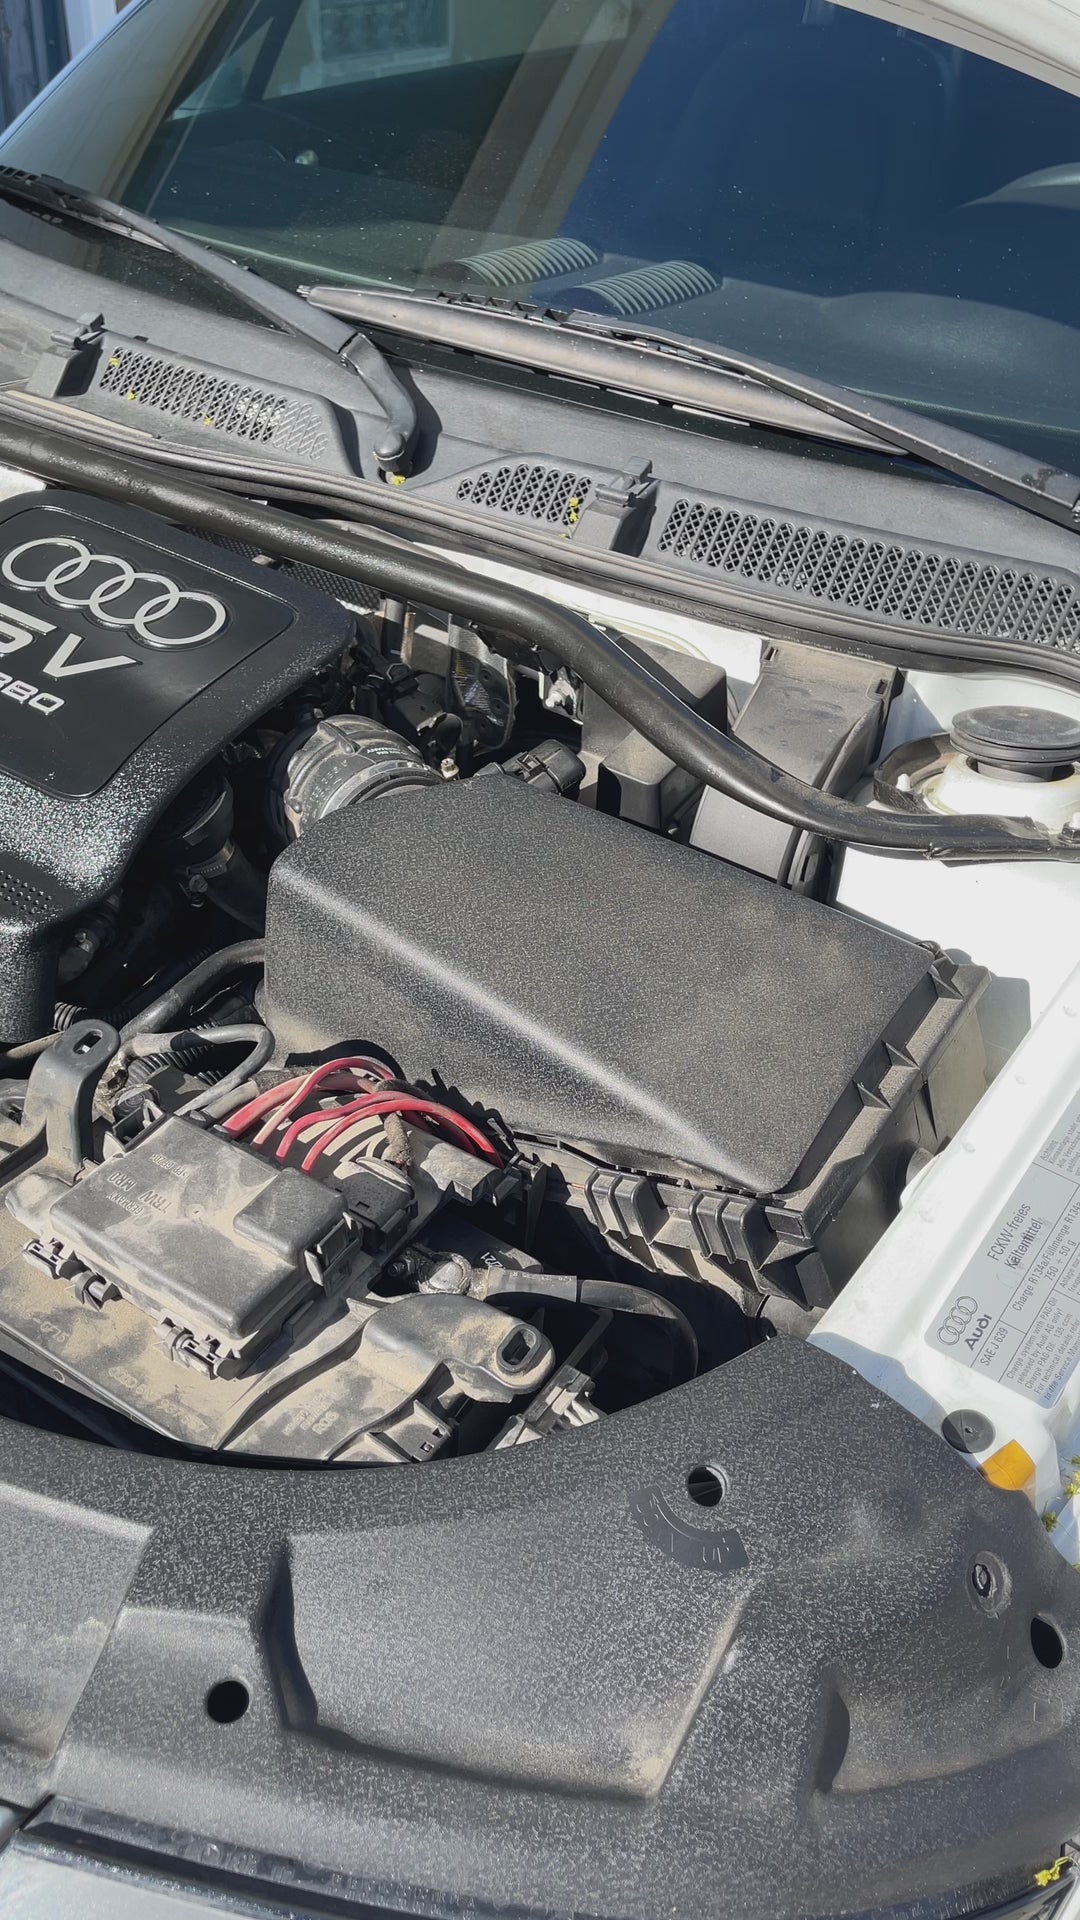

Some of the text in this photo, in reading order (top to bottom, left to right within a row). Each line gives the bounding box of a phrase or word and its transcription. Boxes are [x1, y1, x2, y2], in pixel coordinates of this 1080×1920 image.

[107, 1191, 144, 1216] GERMANY
[138, 1189, 172, 1216] TRW
[987, 1204, 1031, 1261] FCKW-freies
[1005, 1218, 1043, 1269] Kältemittel
[1045, 1266, 1058, 1281] 750
[1060, 1246, 1070, 1256] 50
[1067, 1239, 1076, 1247] g
[1012, 1284, 1034, 1311] Charge
[965, 1314, 992, 1350] Audi
[981, 1328, 1008, 1366] SAE J 639
[1007, 1358, 1023, 1378] Charge
[1021, 1335, 1036, 1357] system
[1034, 1320, 1044, 1334] with
[1016, 1358, 1034, 1384] released
[1031, 1349, 1041, 1359] by
[1037, 1335, 1048, 1349] Audi
[1045, 1323, 1054, 1334] AG
[1024, 1366, 1041, 1389] Charge
[1054, 1327, 1064, 1339] 135
[1034, 1382, 1045, 1395] For
[1041, 1354, 1060, 1382] technical
[1058, 1335, 1072, 1354] details
[1043, 1391, 1052, 1400] to
[1048, 1380, 1058, 1392] the
[1055, 1356, 1072, 1380] Service
